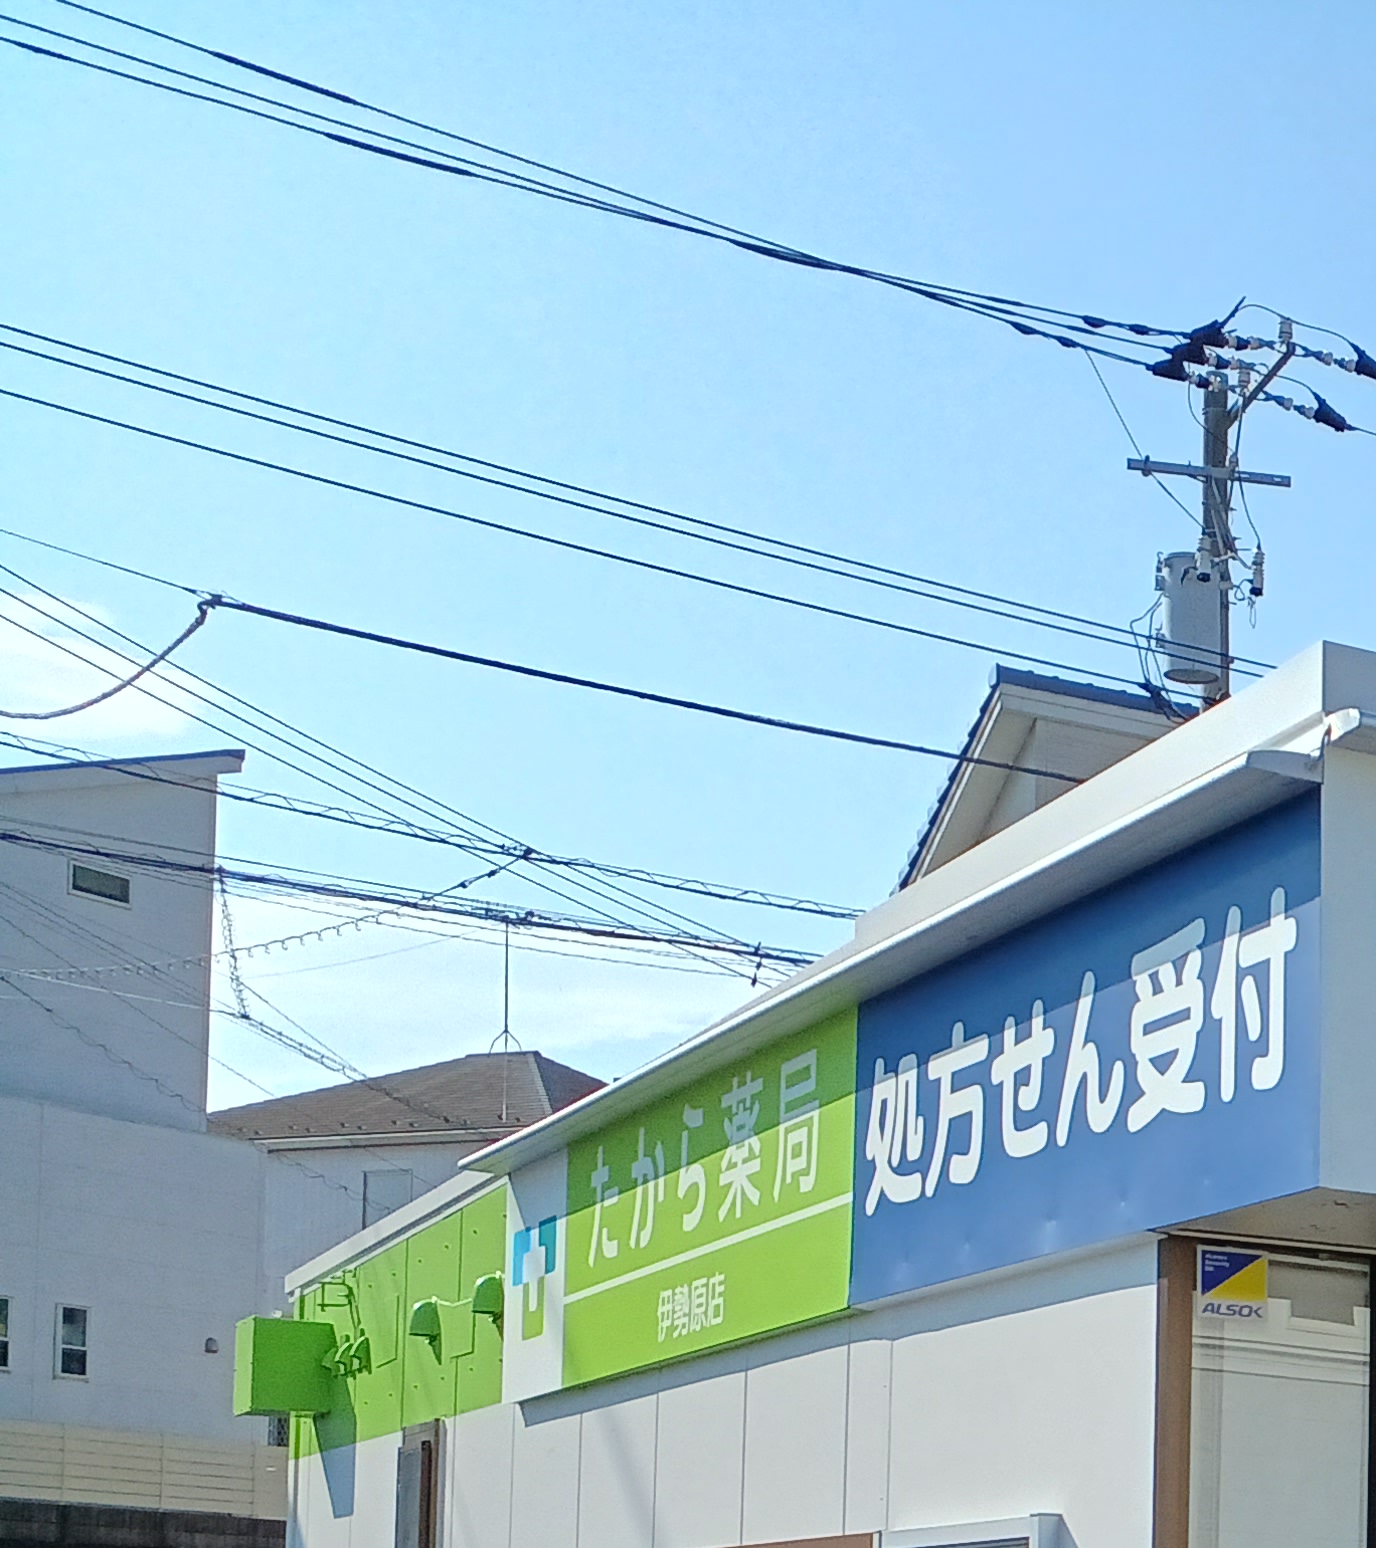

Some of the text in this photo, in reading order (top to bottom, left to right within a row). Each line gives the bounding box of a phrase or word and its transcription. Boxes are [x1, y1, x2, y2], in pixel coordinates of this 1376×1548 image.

[865, 887, 1297, 1217] 処方せん受付
[588, 1049, 820, 1267] たから薬局
[656, 1272, 725, 1342] 伊勢原店
[1201, 1302, 1263, 1319] ALSOK
